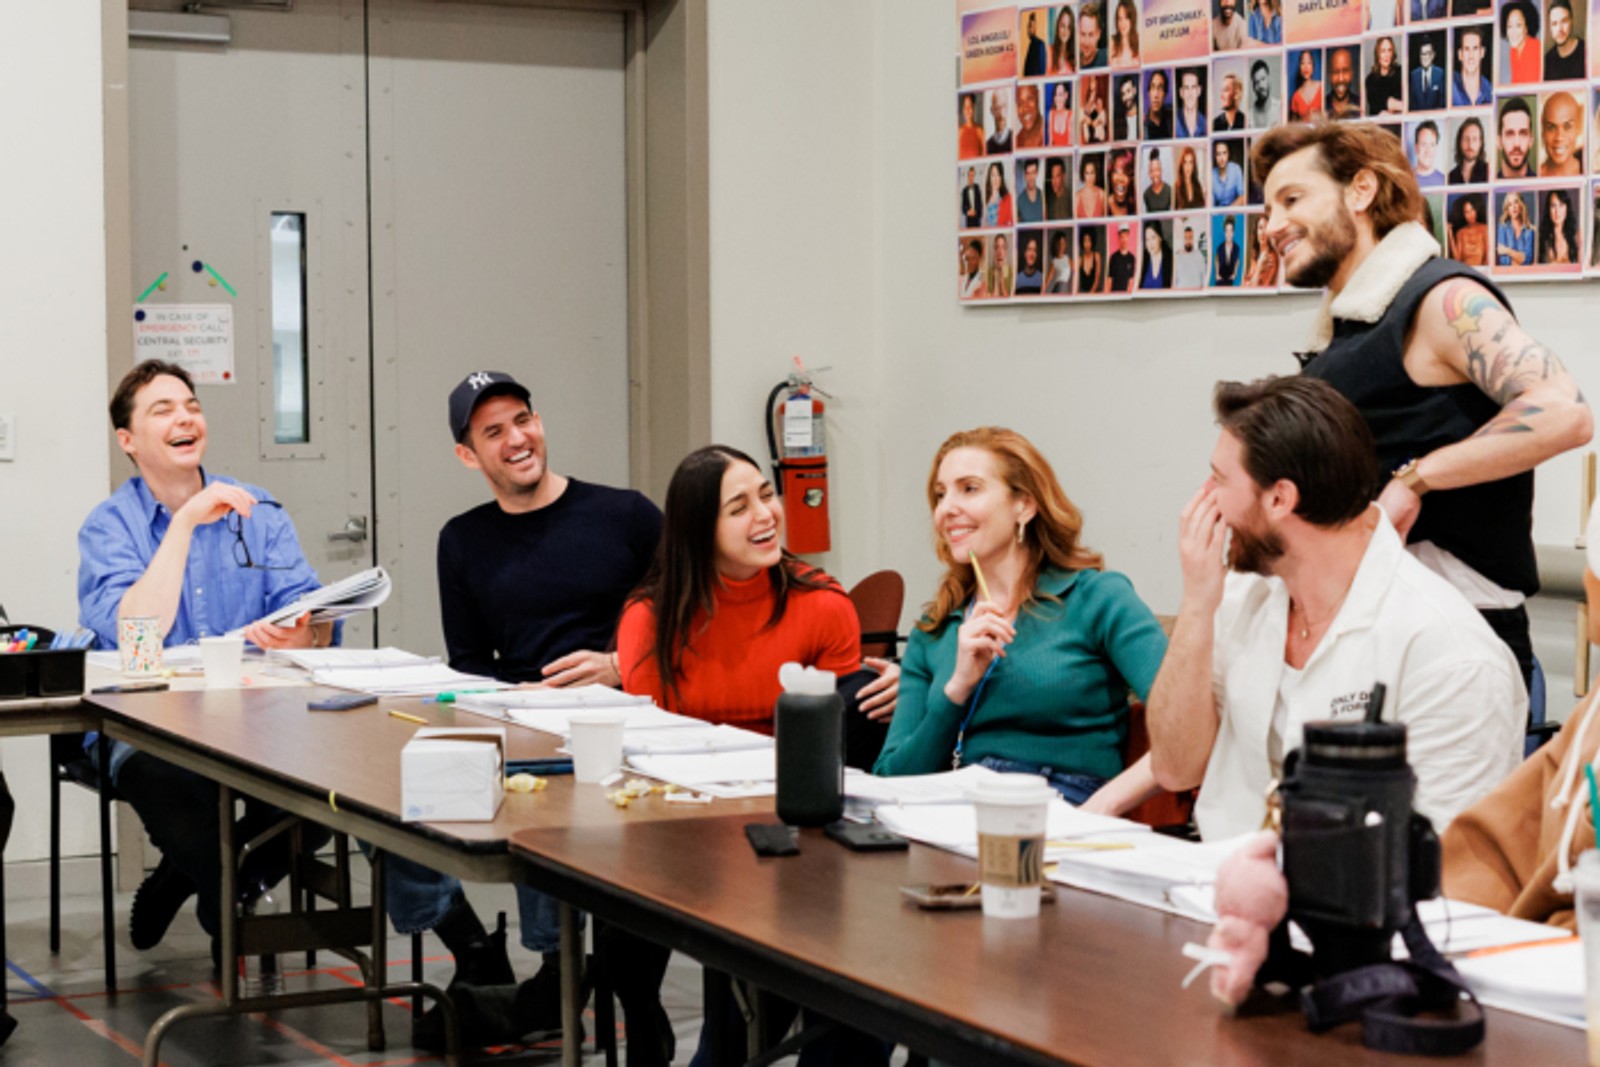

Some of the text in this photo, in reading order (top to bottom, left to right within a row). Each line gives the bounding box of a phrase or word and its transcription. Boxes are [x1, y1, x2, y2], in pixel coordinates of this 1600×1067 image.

[155, 312, 209, 321] IN CASE OF
[139, 323, 224, 332] EMERGENCY CALL
[137, 336, 229, 346] CENTRAL SECURITY
[468, 372, 494, 390] NY
